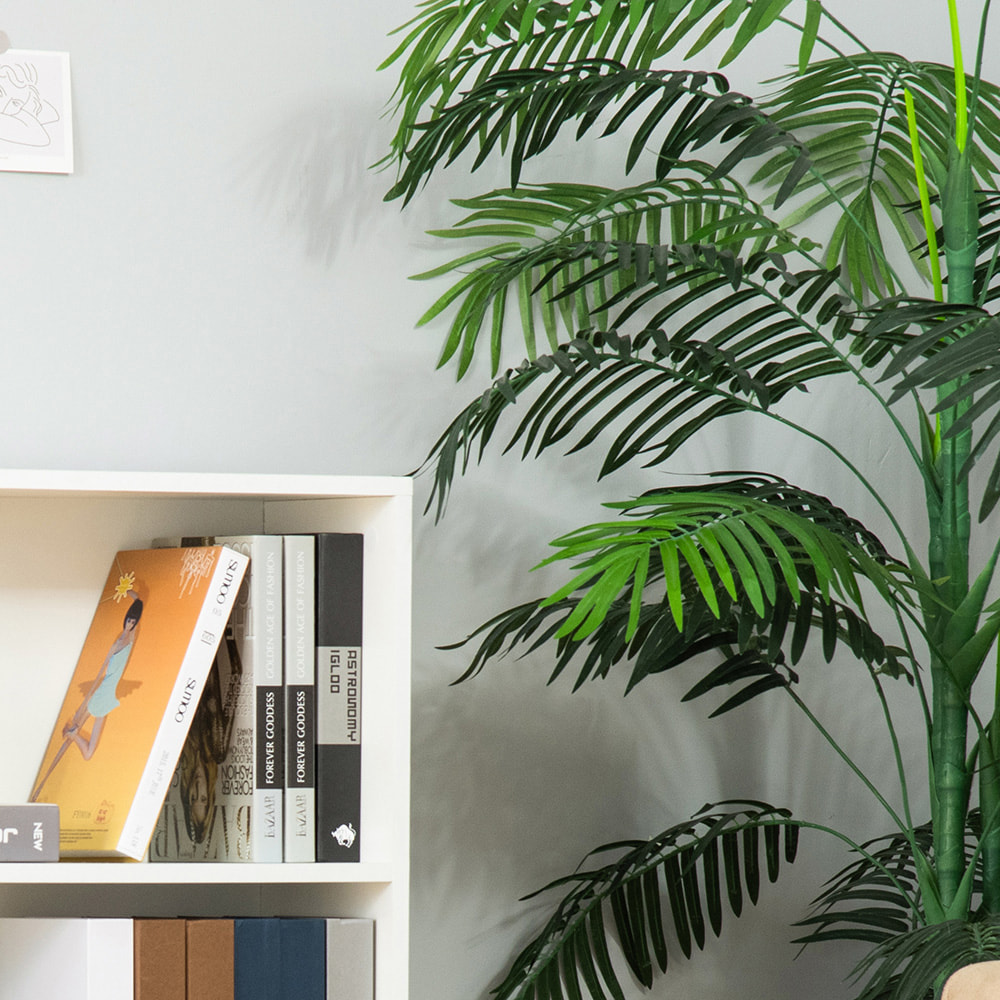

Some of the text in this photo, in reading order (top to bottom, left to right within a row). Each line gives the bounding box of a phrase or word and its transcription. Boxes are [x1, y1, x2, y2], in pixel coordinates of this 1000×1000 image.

[264, 551, 275, 679] GOLDEN AGE OF FASHION
[295, 550, 306, 678] GOLDEN AGE OF FASHION
[330, 650, 340, 694] IGLOO
[347, 650, 357, 742] ASTRONOMY
[221, 765, 253, 780] FASHION
[265, 692, 275, 784] FOREVER GODDESS
[296, 691, 306, 783] FOREVER GODDESS
[222, 781, 253, 796] FOREVER
[33, 822, 43, 851] NEW
